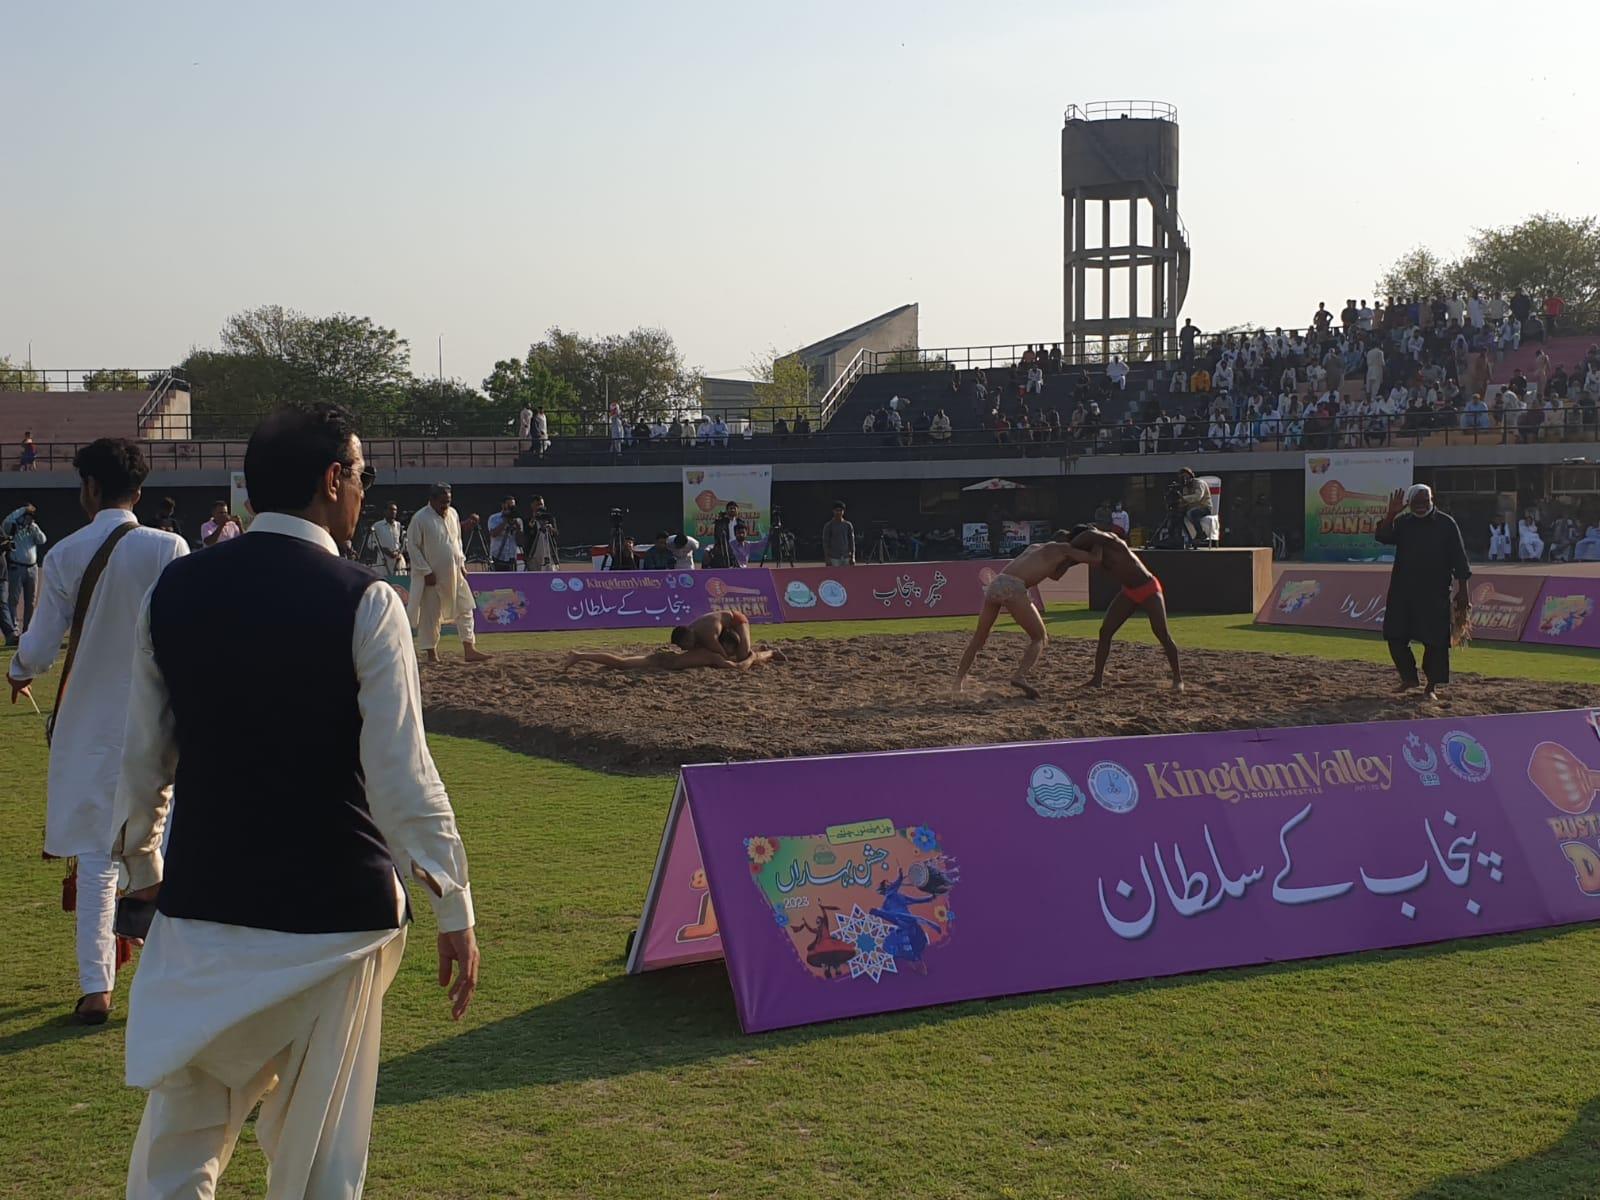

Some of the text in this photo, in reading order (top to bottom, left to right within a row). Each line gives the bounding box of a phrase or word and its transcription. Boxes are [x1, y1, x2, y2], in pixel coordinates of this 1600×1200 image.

[566, 590, 691, 621] پنجاب کے سلطان
[872, 574, 922, 607] پنجاب
[1144, 748, 1393, 805] KingdomValley
[1251, 790, 1280, 798] ROYAL
[1280, 786, 1323, 796] LIFESTYLE
[1547, 813, 1600, 841] RUST
[775, 858, 855, 894] بہاراں
[1097, 802, 1505, 940] پنجاب کے سلطان
[783, 896, 810, 909] 2023
